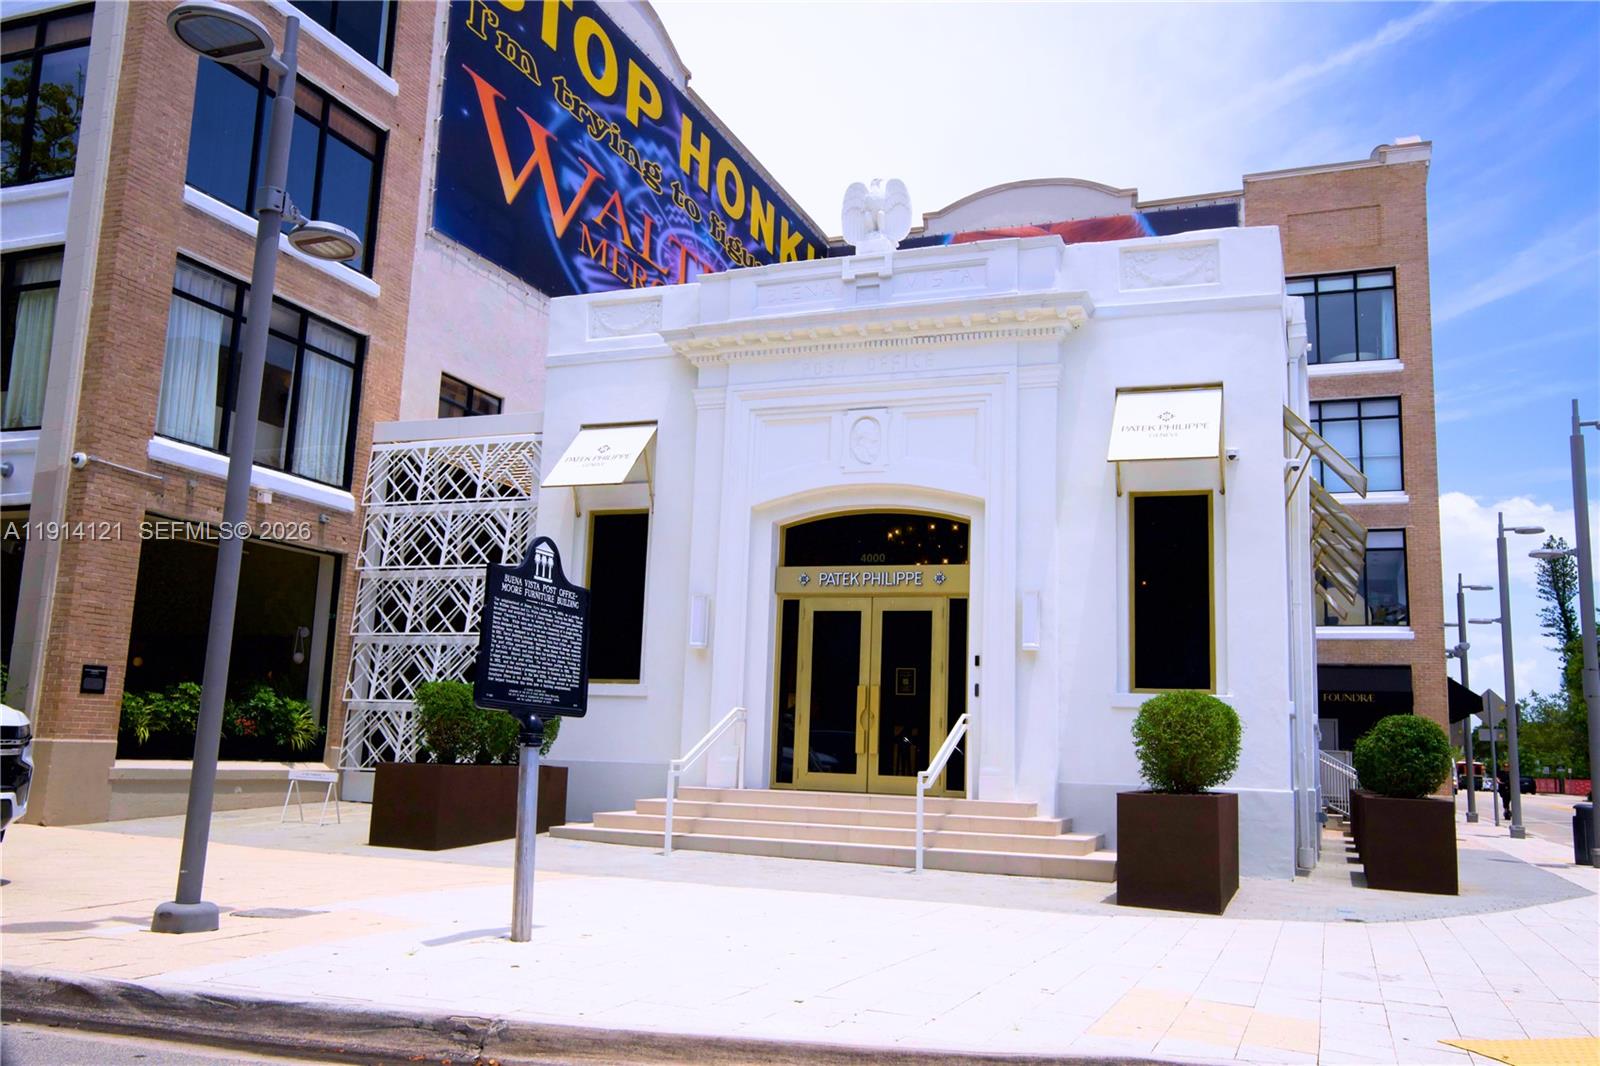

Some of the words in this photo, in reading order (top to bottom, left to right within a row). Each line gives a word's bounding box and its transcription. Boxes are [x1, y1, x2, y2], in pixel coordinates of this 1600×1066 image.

[498, 0, 663, 128] TOP
[552, 76, 663, 195] trying
[671, 181, 702, 223] to
[462, 63, 716, 285] WALT
[860, 553, 886, 563] 4000
[504, 573, 523, 586] BUENA
[524, 579, 541, 591] VISTA
[542, 584, 557, 595] POST
[818, 572, 860, 586] PATEK
[862, 571, 923, 586] PHILIPPE
[501, 582, 523, 595] MOORE
[524, 588, 555, 603] FURNITURE
[556, 596, 580, 609] BUILDING
